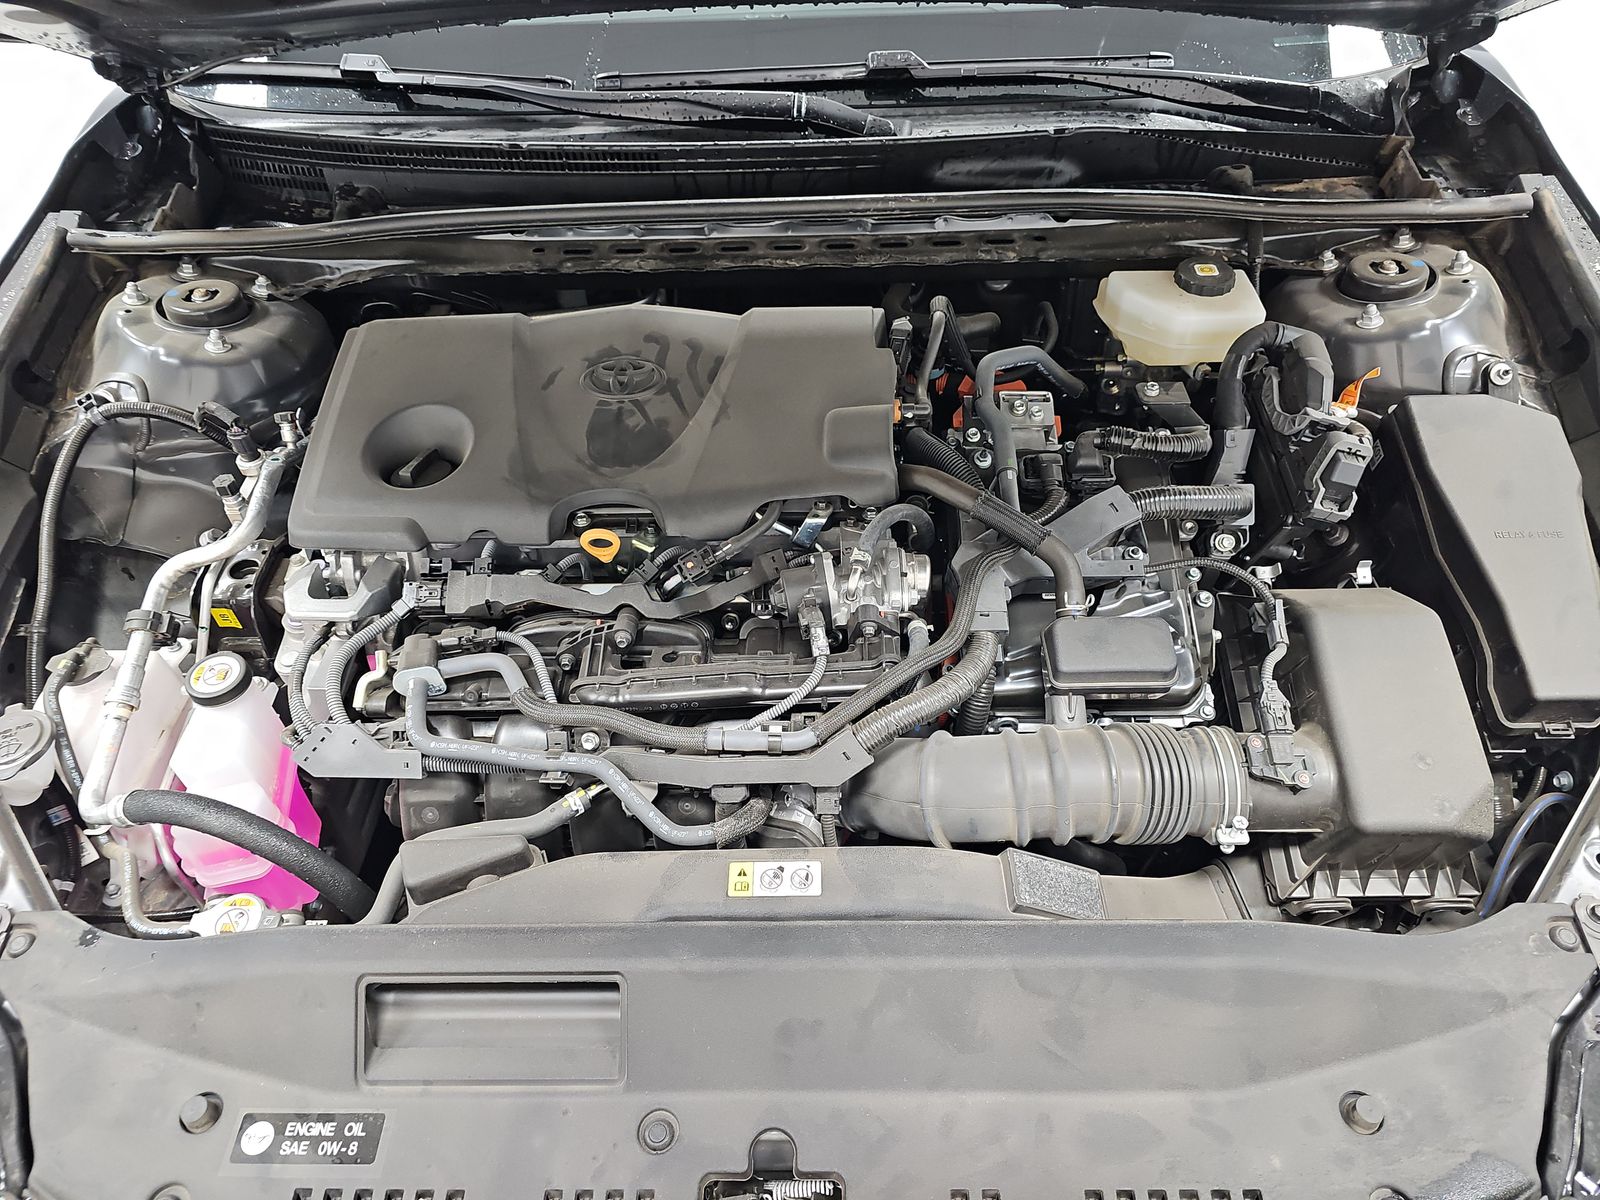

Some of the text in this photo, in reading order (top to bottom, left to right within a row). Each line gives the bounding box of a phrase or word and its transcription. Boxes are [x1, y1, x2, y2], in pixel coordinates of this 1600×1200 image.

[1493, 530, 1526, 539] RELAY
[1536, 530, 1564, 539] FUSE
[284, 1121, 366, 1137] ENGINE OIL
[279, 1140, 358, 1156] SAE 0W-8
